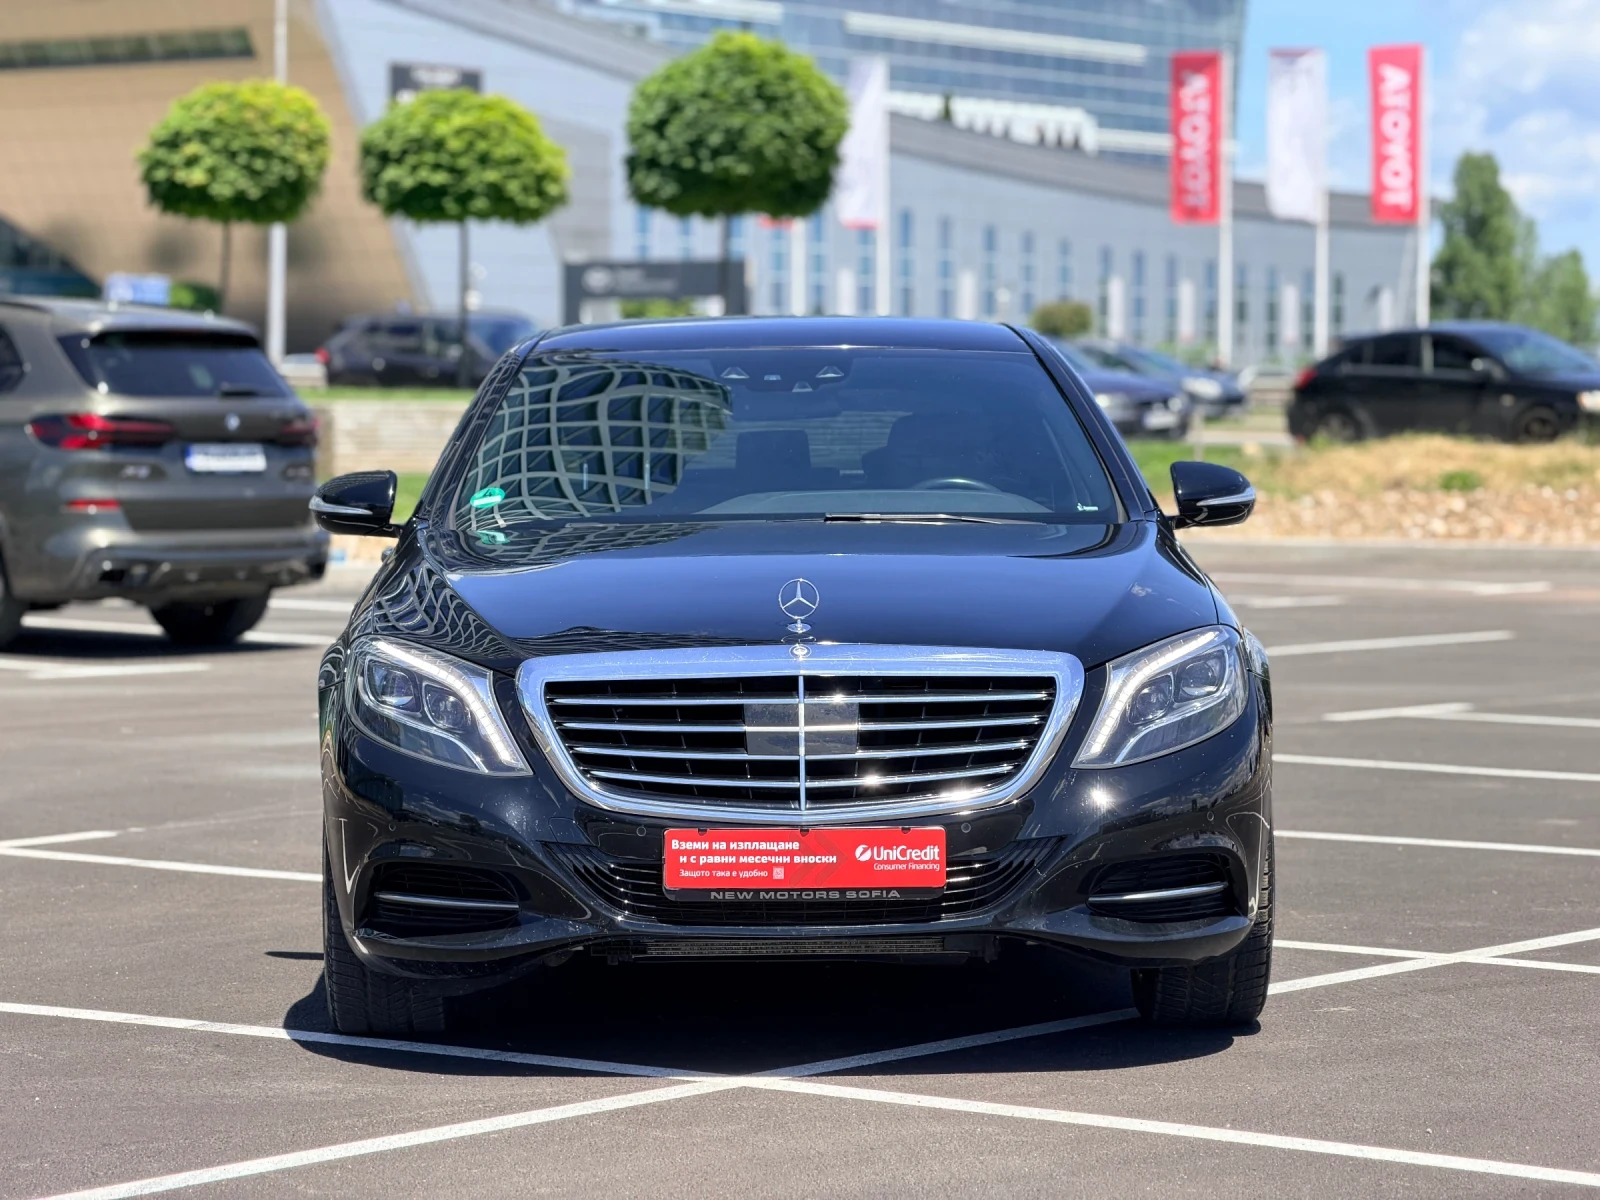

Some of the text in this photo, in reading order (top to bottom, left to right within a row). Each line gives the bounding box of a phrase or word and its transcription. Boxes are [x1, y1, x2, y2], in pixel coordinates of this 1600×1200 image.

[671, 839, 800, 852] Вземи на изплащане
[873, 845, 940, 861] UniCredit
[679, 856, 837, 866] и с равни месечни вноски
[873, 862, 940, 872] Consumer Financing
[679, 868, 710, 878] Защото
[739, 868, 768, 878] удобно
[710, 889, 901, 900] NEW MOTORS SOFIA
